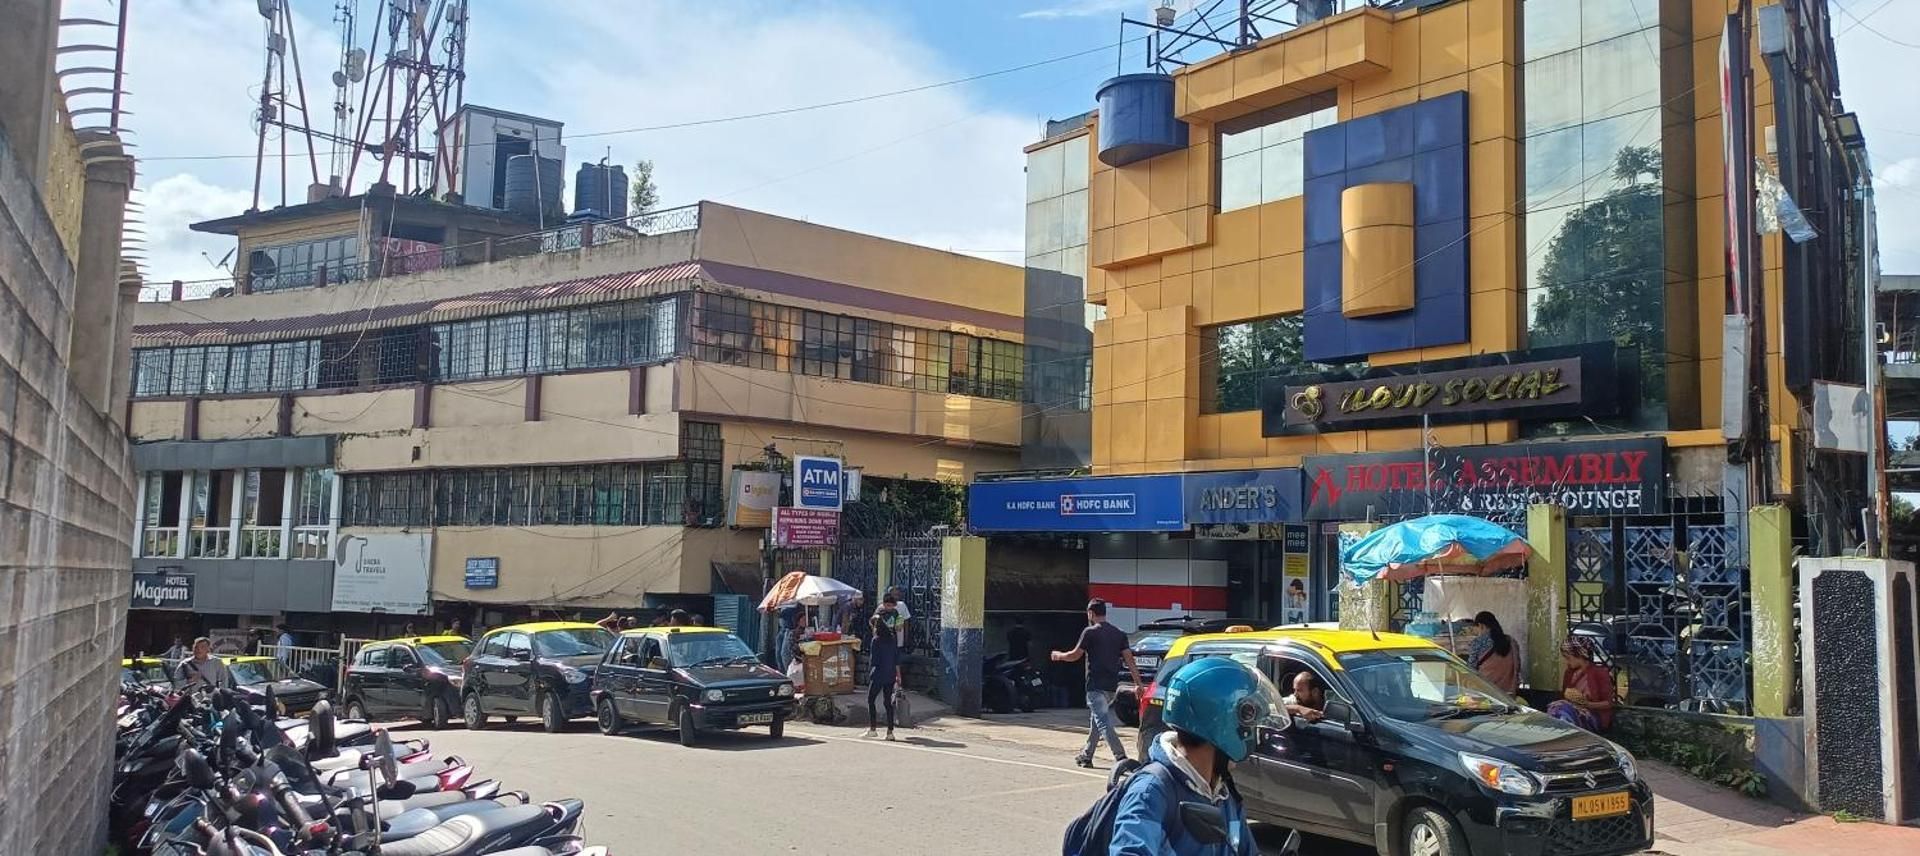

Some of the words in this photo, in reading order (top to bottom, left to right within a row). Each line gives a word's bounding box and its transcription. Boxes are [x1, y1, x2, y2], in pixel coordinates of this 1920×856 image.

[1442, 367, 1568, 405] SOCIAL
[803, 468, 838, 486] ATM
[1346, 461, 1443, 492] HOTEL
[1456, 451, 1649, 488] ASSEMBLY
[1200, 485, 1277, 510] ANDER'S
[1018, 502, 1035, 510] HDFC
[1077, 500, 1101, 510] HDFC
[1103, 500, 1131, 510] BANK
[1287, 531, 1305, 539] mee
[1287, 540, 1305, 548] mee
[166, 576, 190, 586] HOTEL
[133, 580, 189, 606] Magnum
